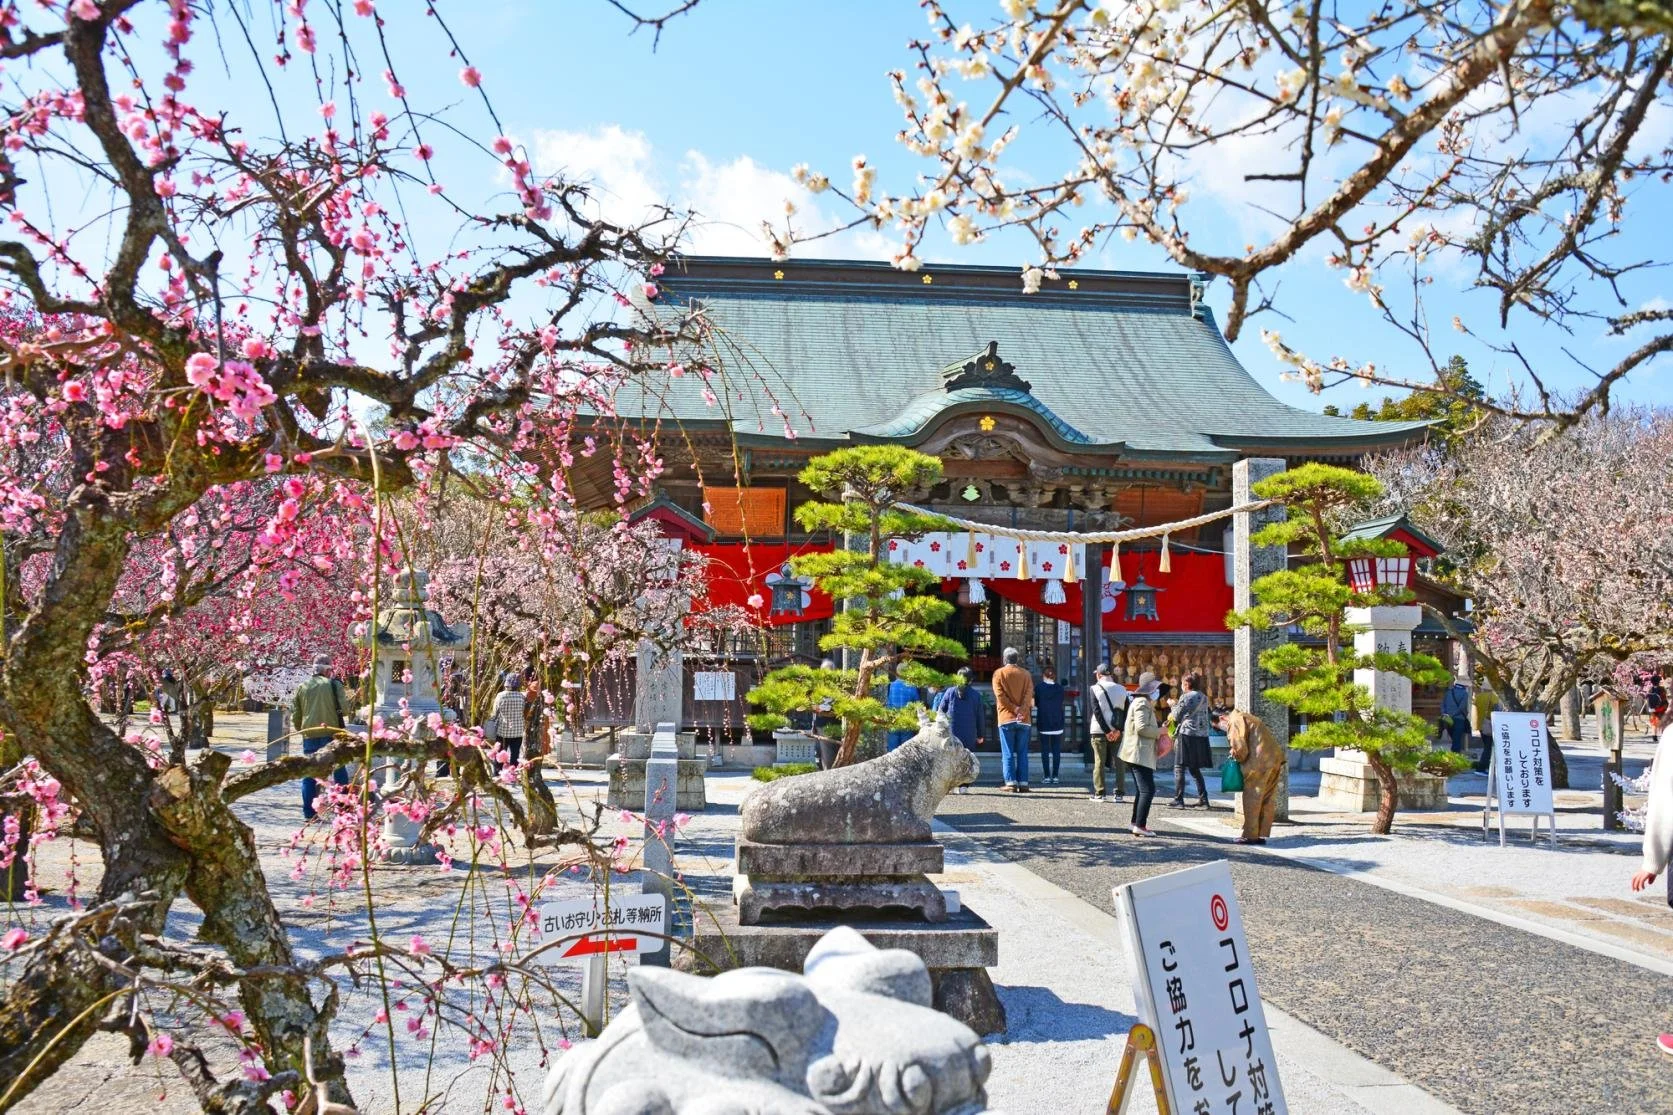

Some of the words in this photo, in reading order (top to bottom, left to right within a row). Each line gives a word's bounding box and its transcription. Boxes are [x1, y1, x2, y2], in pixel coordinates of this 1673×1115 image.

[1501, 723, 1515, 808] ご協力をお願いします
[1519, 750, 1531, 808] しております
[1530, 729, 1544, 786] コロナ対策を
